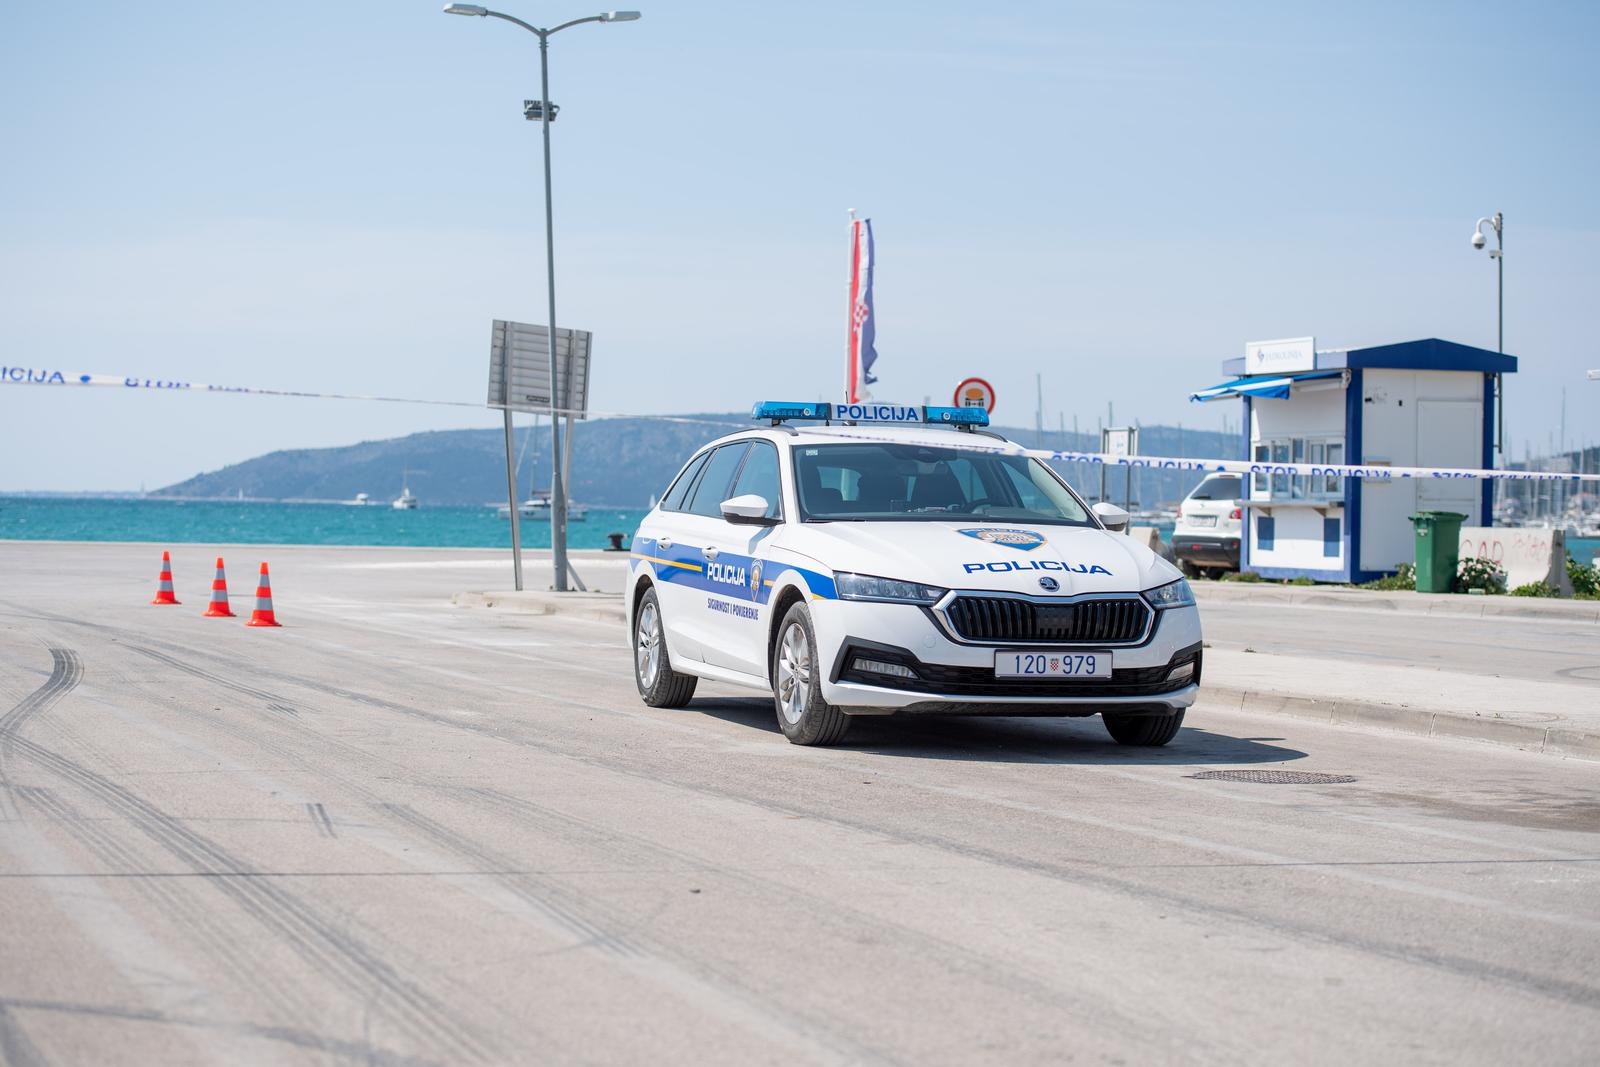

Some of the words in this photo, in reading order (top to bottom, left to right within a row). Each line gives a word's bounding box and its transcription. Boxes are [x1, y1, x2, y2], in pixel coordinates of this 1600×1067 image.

[836, 404, 918, 421] POLICIJA
[707, 562, 746, 587] POLICIJA
[962, 560, 1114, 577] POLICIJA
[1015, 654, 1046, 674] 120
[1062, 655, 1096, 675] 979
